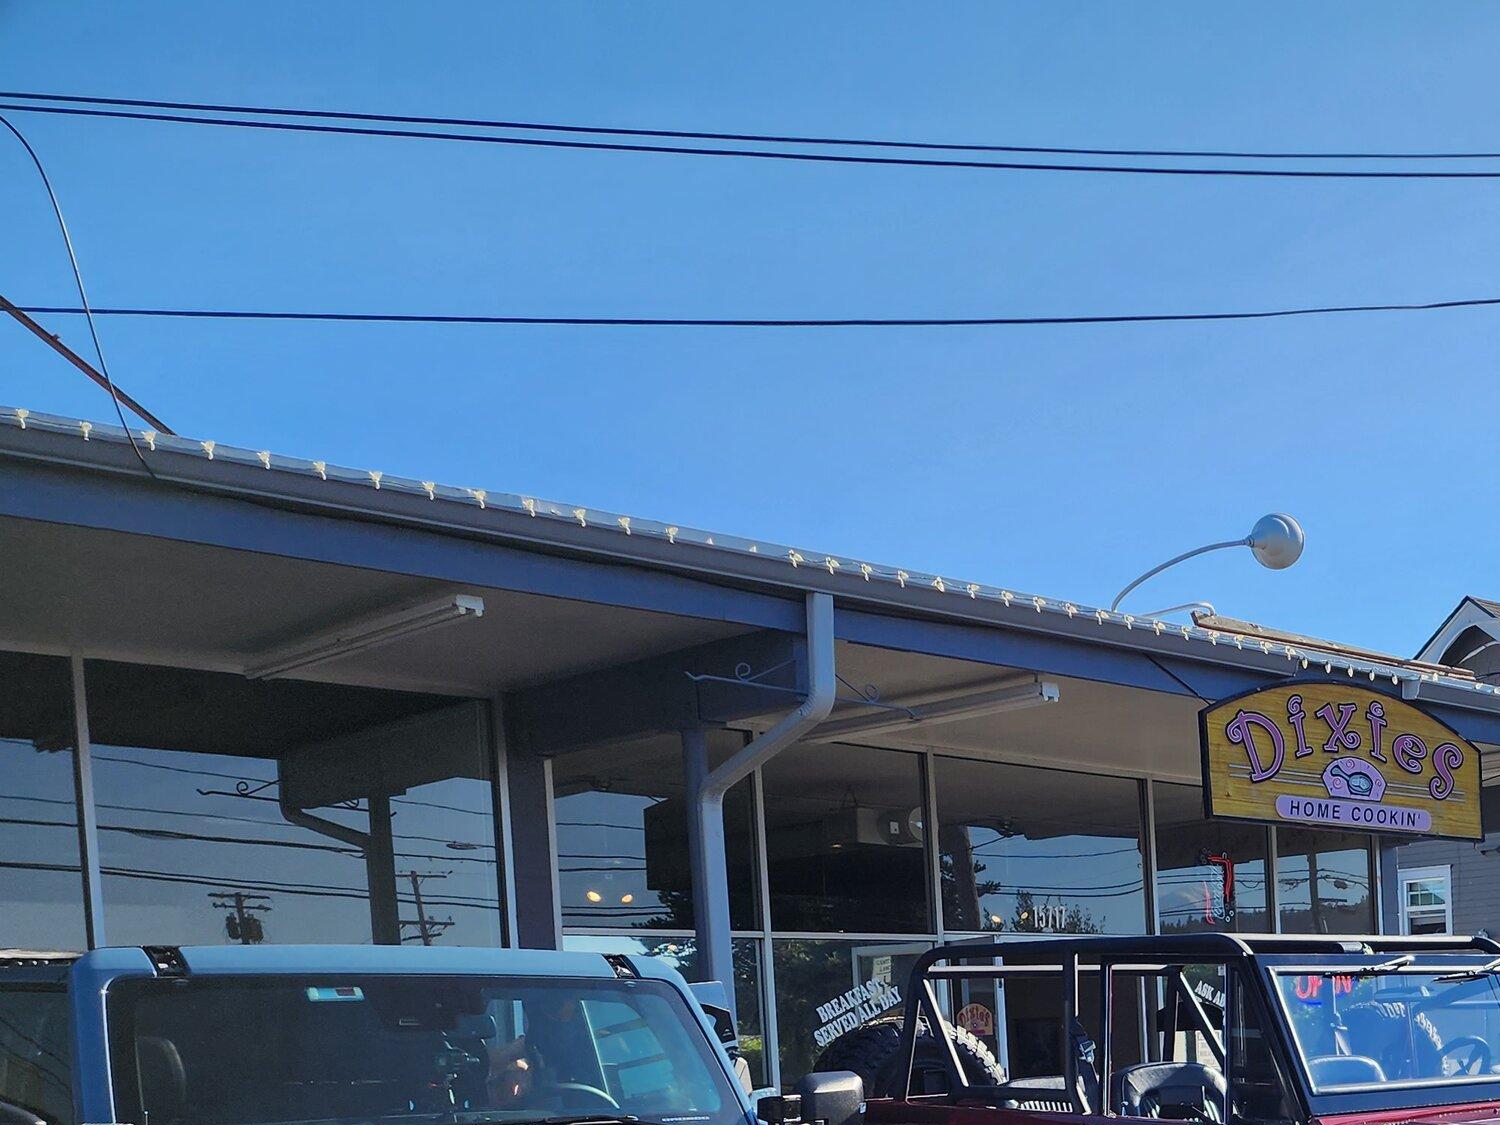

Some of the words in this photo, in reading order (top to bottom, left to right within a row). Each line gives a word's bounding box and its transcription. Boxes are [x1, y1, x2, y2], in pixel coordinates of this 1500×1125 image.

[1226, 694, 1464, 800] Dixies
[1290, 801, 1341, 820] HOME
[1351, 807, 1422, 827] COOKIN'
[1033, 906, 1067, 929] 15717
[816, 977, 886, 1023] BREAKFAST
[1194, 980, 1214, 1001] ASK
[814, 1011, 859, 1047] SERVED
[858, 1001, 881, 1022] ALL
[879, 986, 902, 1011] DAY
